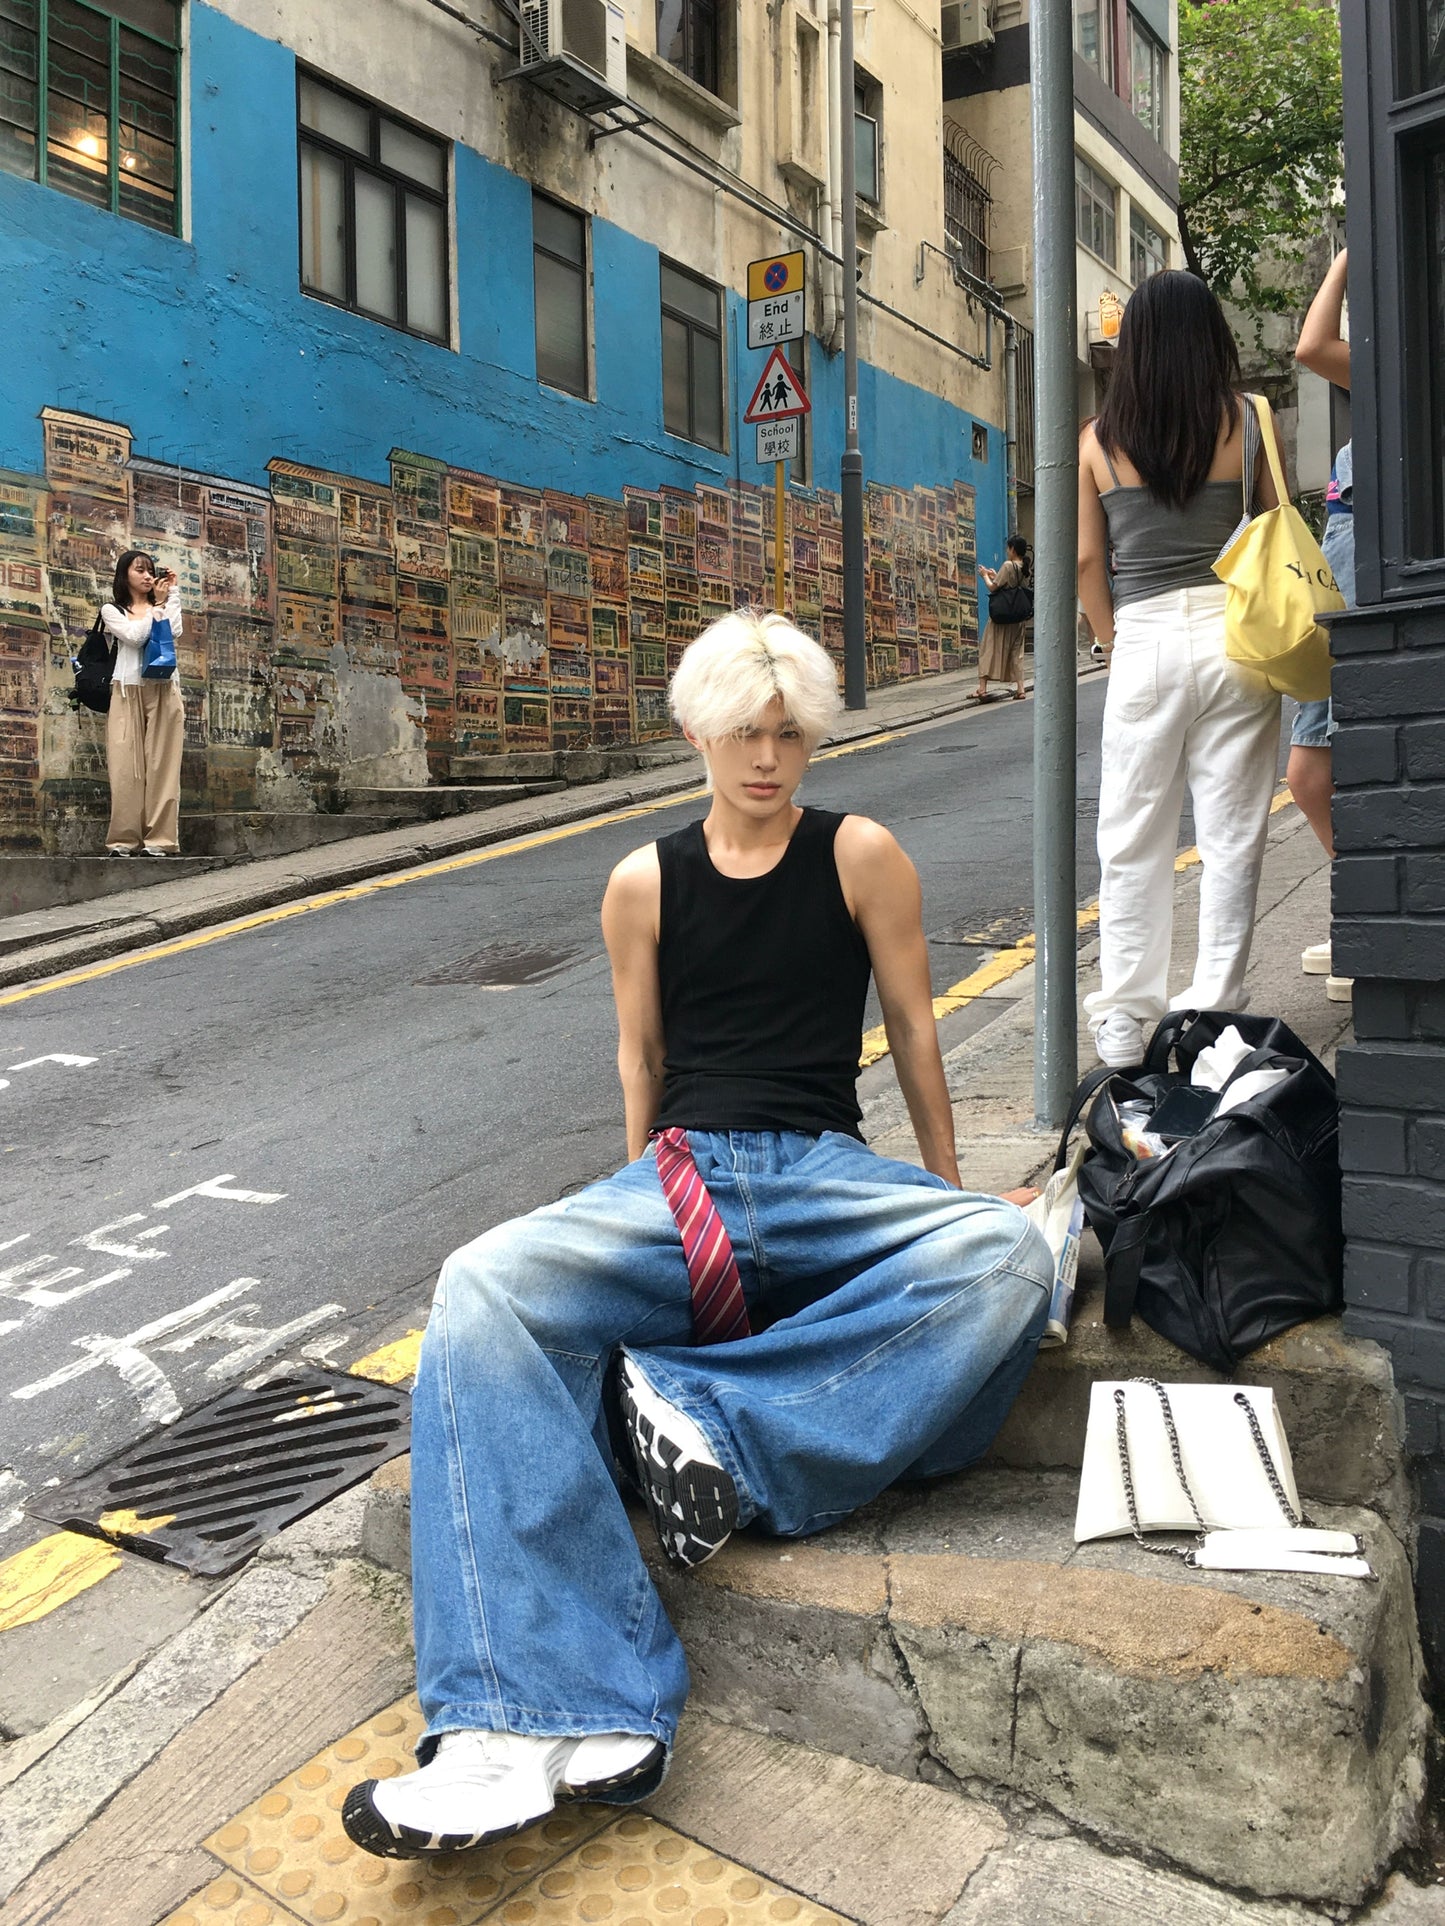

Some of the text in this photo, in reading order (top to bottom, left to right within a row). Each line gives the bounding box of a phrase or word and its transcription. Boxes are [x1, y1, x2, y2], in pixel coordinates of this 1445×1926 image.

[764, 300, 789, 317] End
[759, 318, 793, 340] 終止
[760, 424, 794, 438] School
[764, 439, 790, 456] 學校
[0, 1173, 290, 1336] EFT
